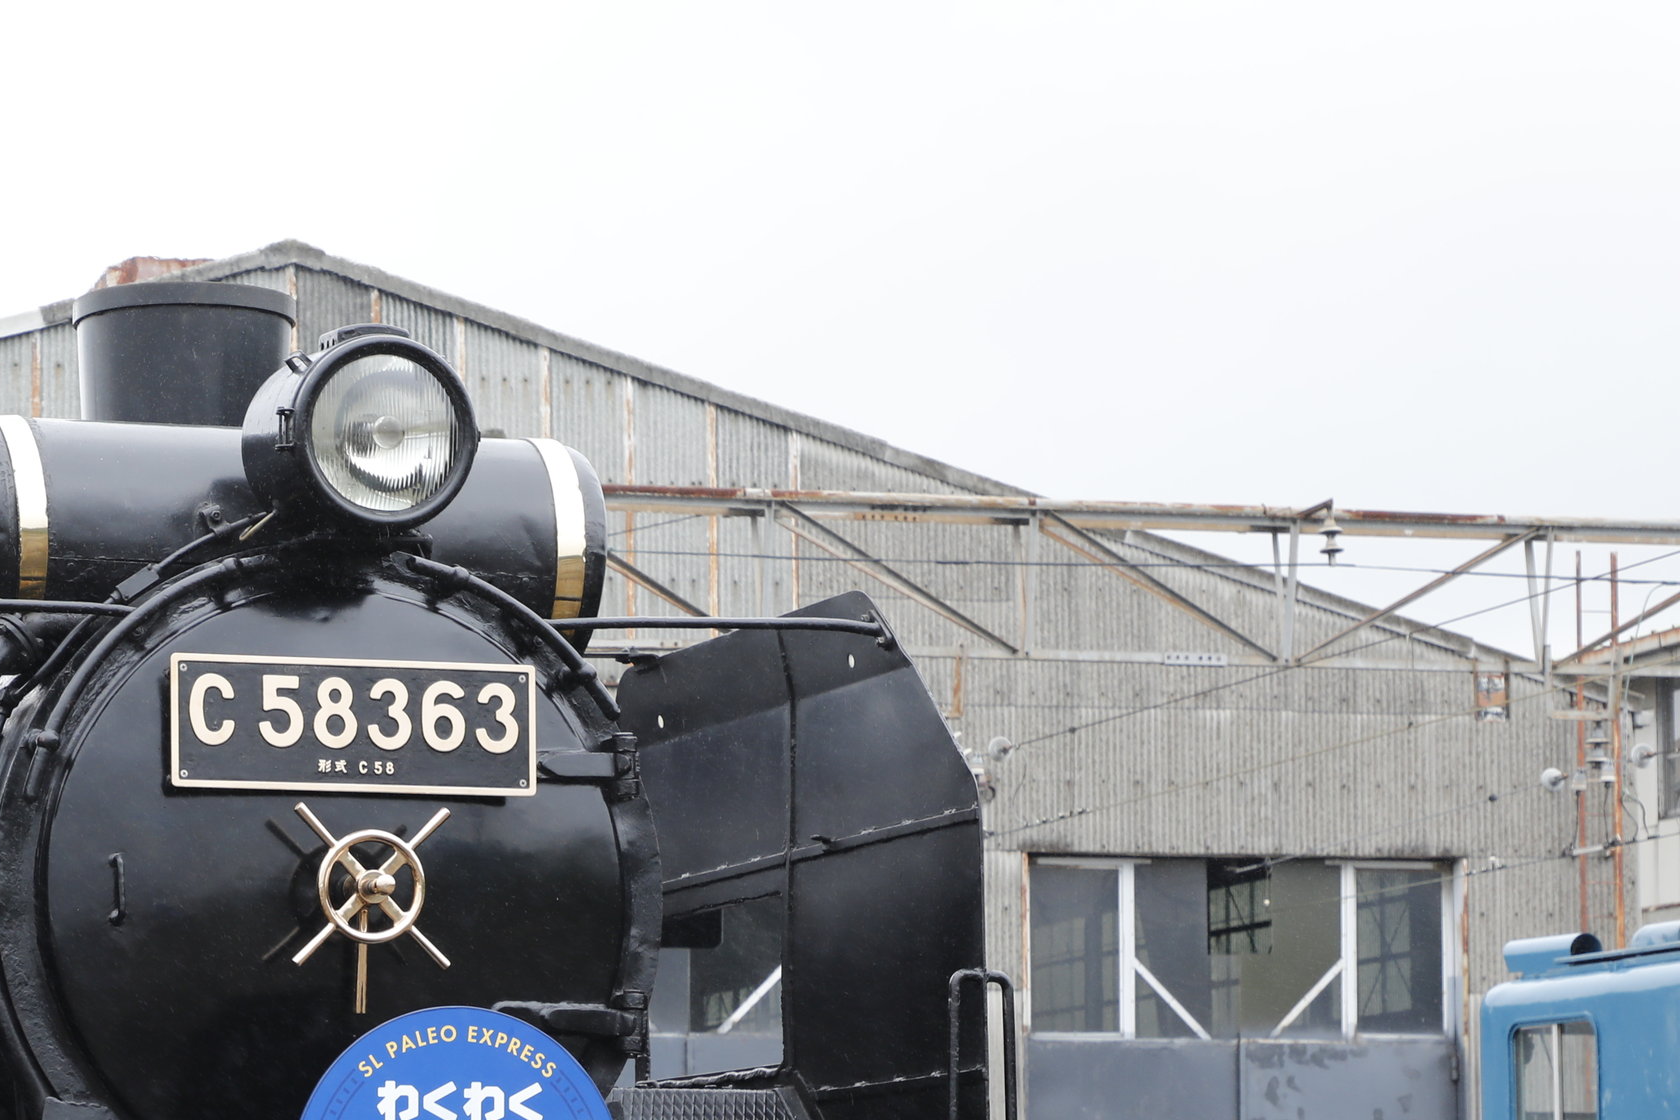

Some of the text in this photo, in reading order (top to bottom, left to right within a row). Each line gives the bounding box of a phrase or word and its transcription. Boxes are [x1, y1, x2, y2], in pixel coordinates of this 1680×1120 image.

[317, 759, 348, 774] 形式
[358, 1025, 556, 1078] SL PALEO EXPRESS
